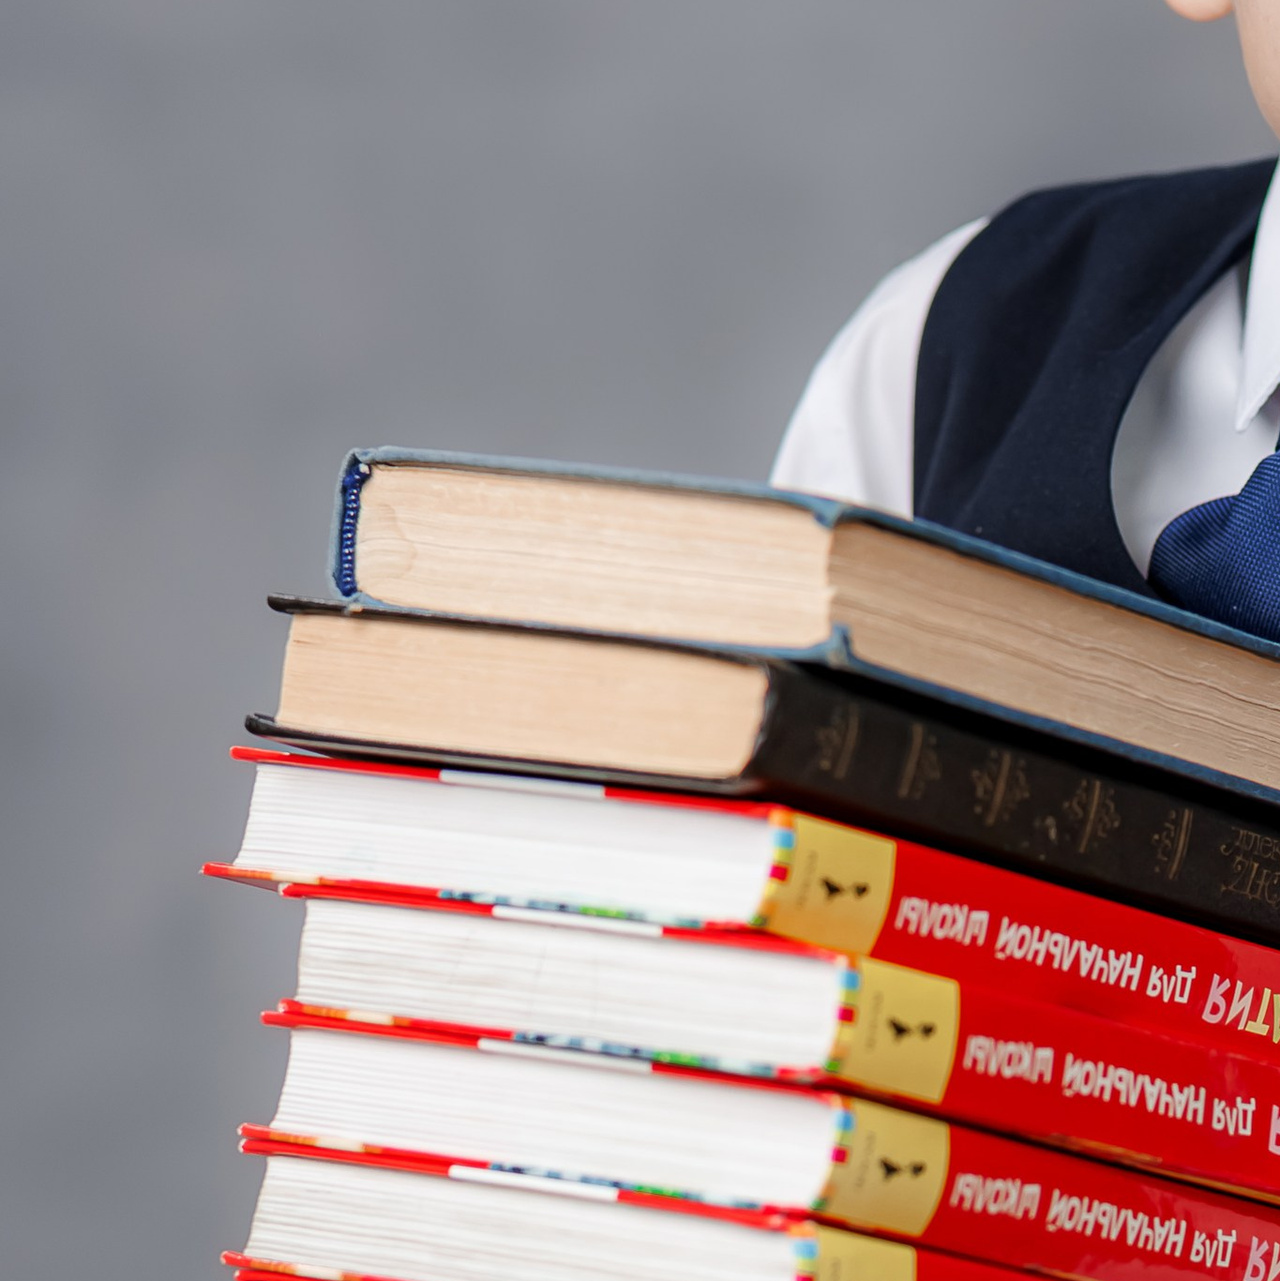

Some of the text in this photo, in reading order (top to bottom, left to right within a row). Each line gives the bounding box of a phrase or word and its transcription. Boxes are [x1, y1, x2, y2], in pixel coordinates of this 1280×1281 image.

[895, 897, 990, 946] ШКОЛЫ
[995, 917, 1144, 991] НАЧАЛЬНОЙ
[963, 1035, 1054, 1083] ШКОЛЫ
[1062, 1053, 1206, 1125] НАЧАЛЬНОЙ
[950, 1173, 1041, 1219] ШКОЛЫ
[1047, 1189, 1187, 1256] НАЧАЛЬНОЙ
